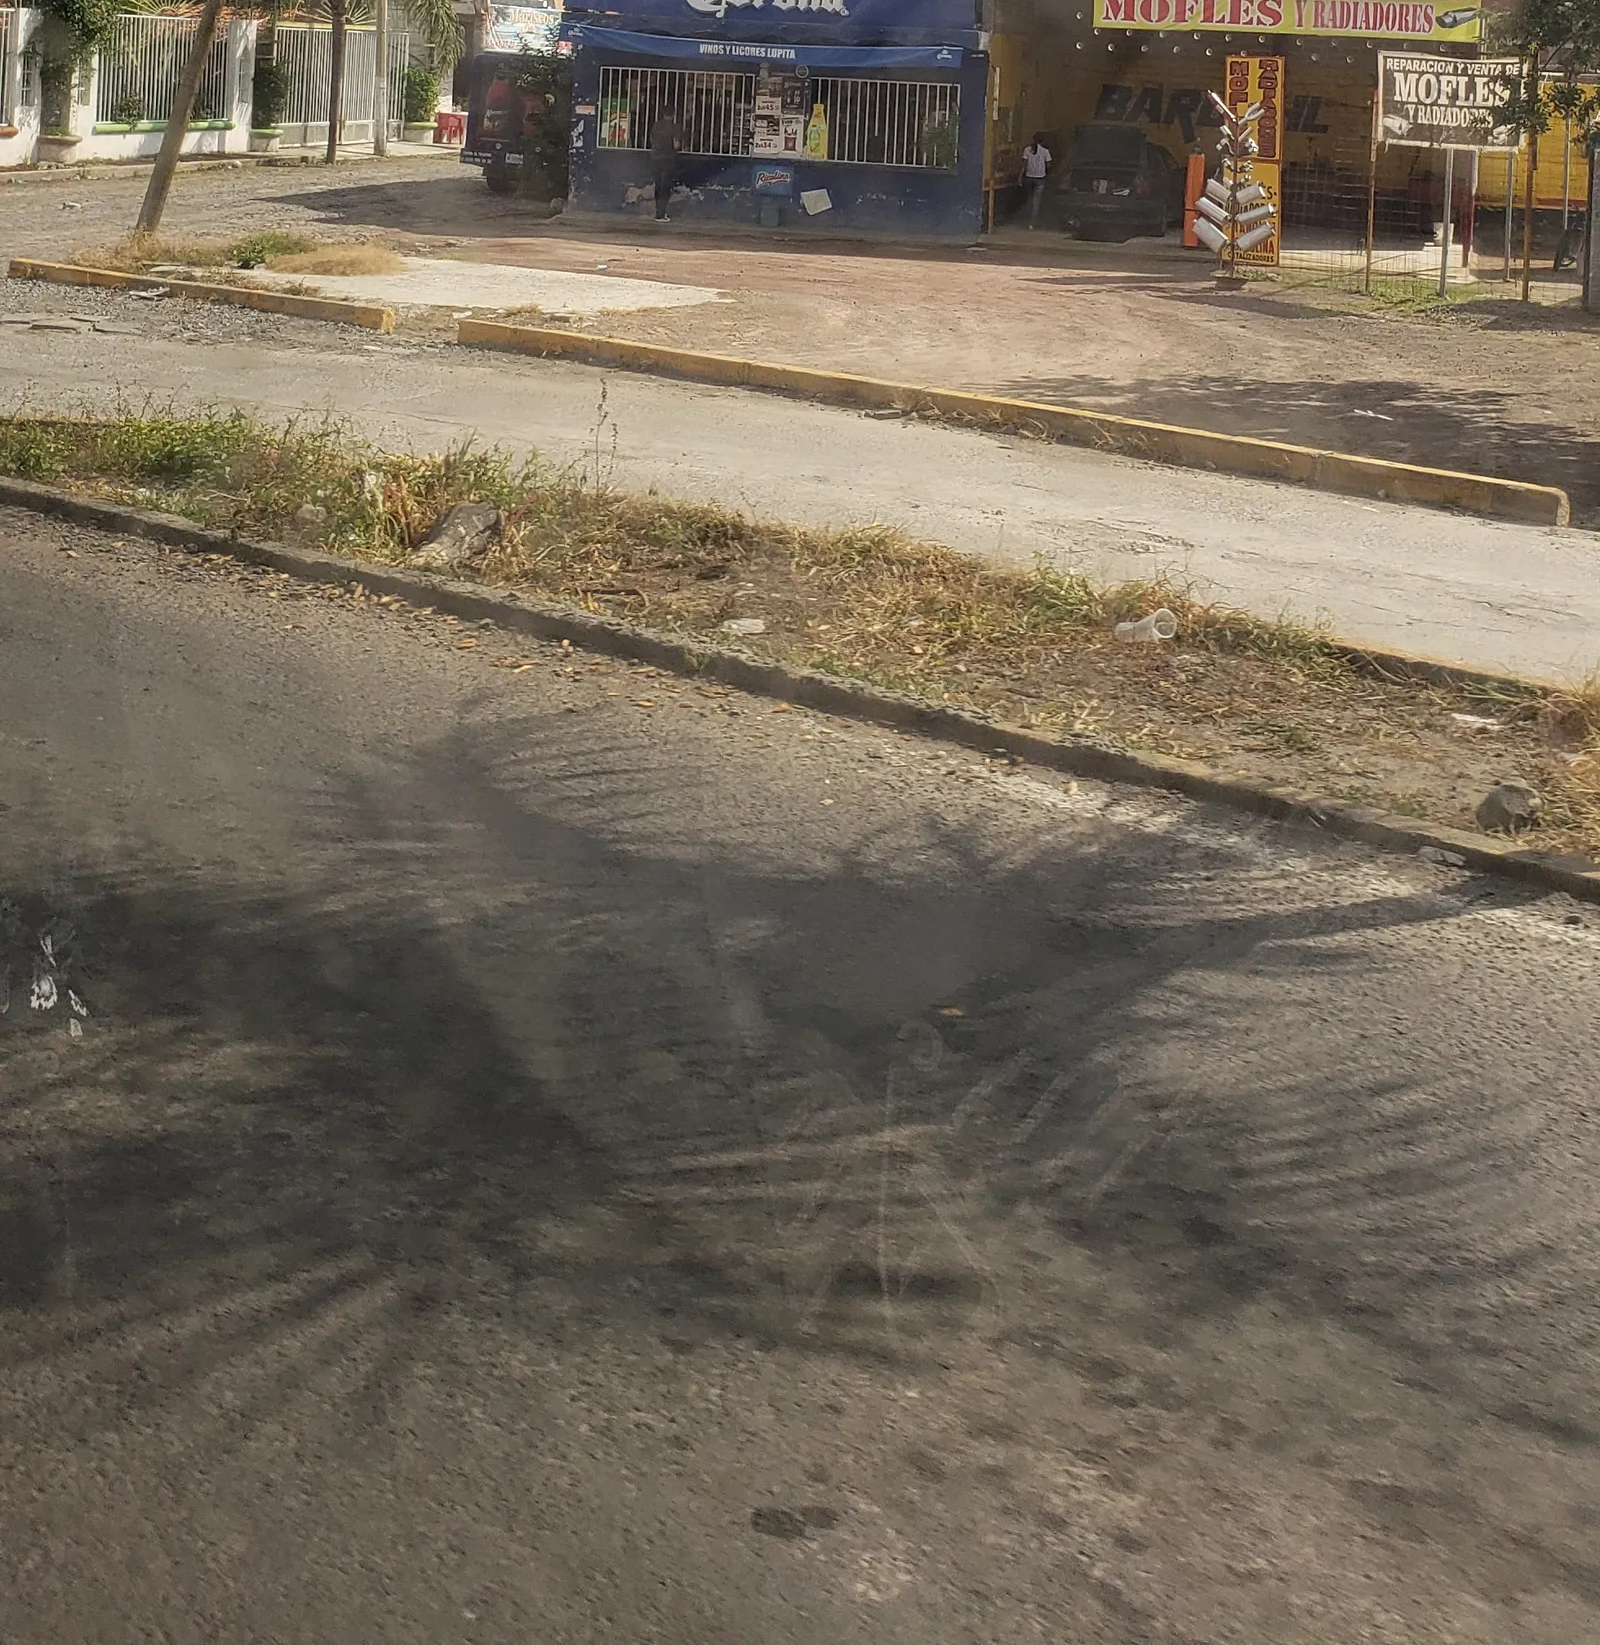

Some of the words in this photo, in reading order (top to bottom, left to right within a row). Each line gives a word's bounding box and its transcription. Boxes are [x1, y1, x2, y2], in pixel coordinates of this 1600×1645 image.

[1295, 0, 1308, 28] Y
[1313, 0, 1435, 34] RADIADORES
[699, 44, 724, 54] VINOS
[723, 45, 731, 54] Y
[732, 45, 766, 57] LICORES
[767, 47, 796, 59] LUPITA
[1386, 58, 1455, 74] REPARACION
[1456, 62, 1465, 74] Y
[1466, 63, 1502, 76] VENTA
[1505, 64, 1521, 75] DE
[1393, 72, 1511, 108] MOFLES
[1407, 105, 1416, 123] Y
[1228, 251, 1275, 263] CTALIZADORES
